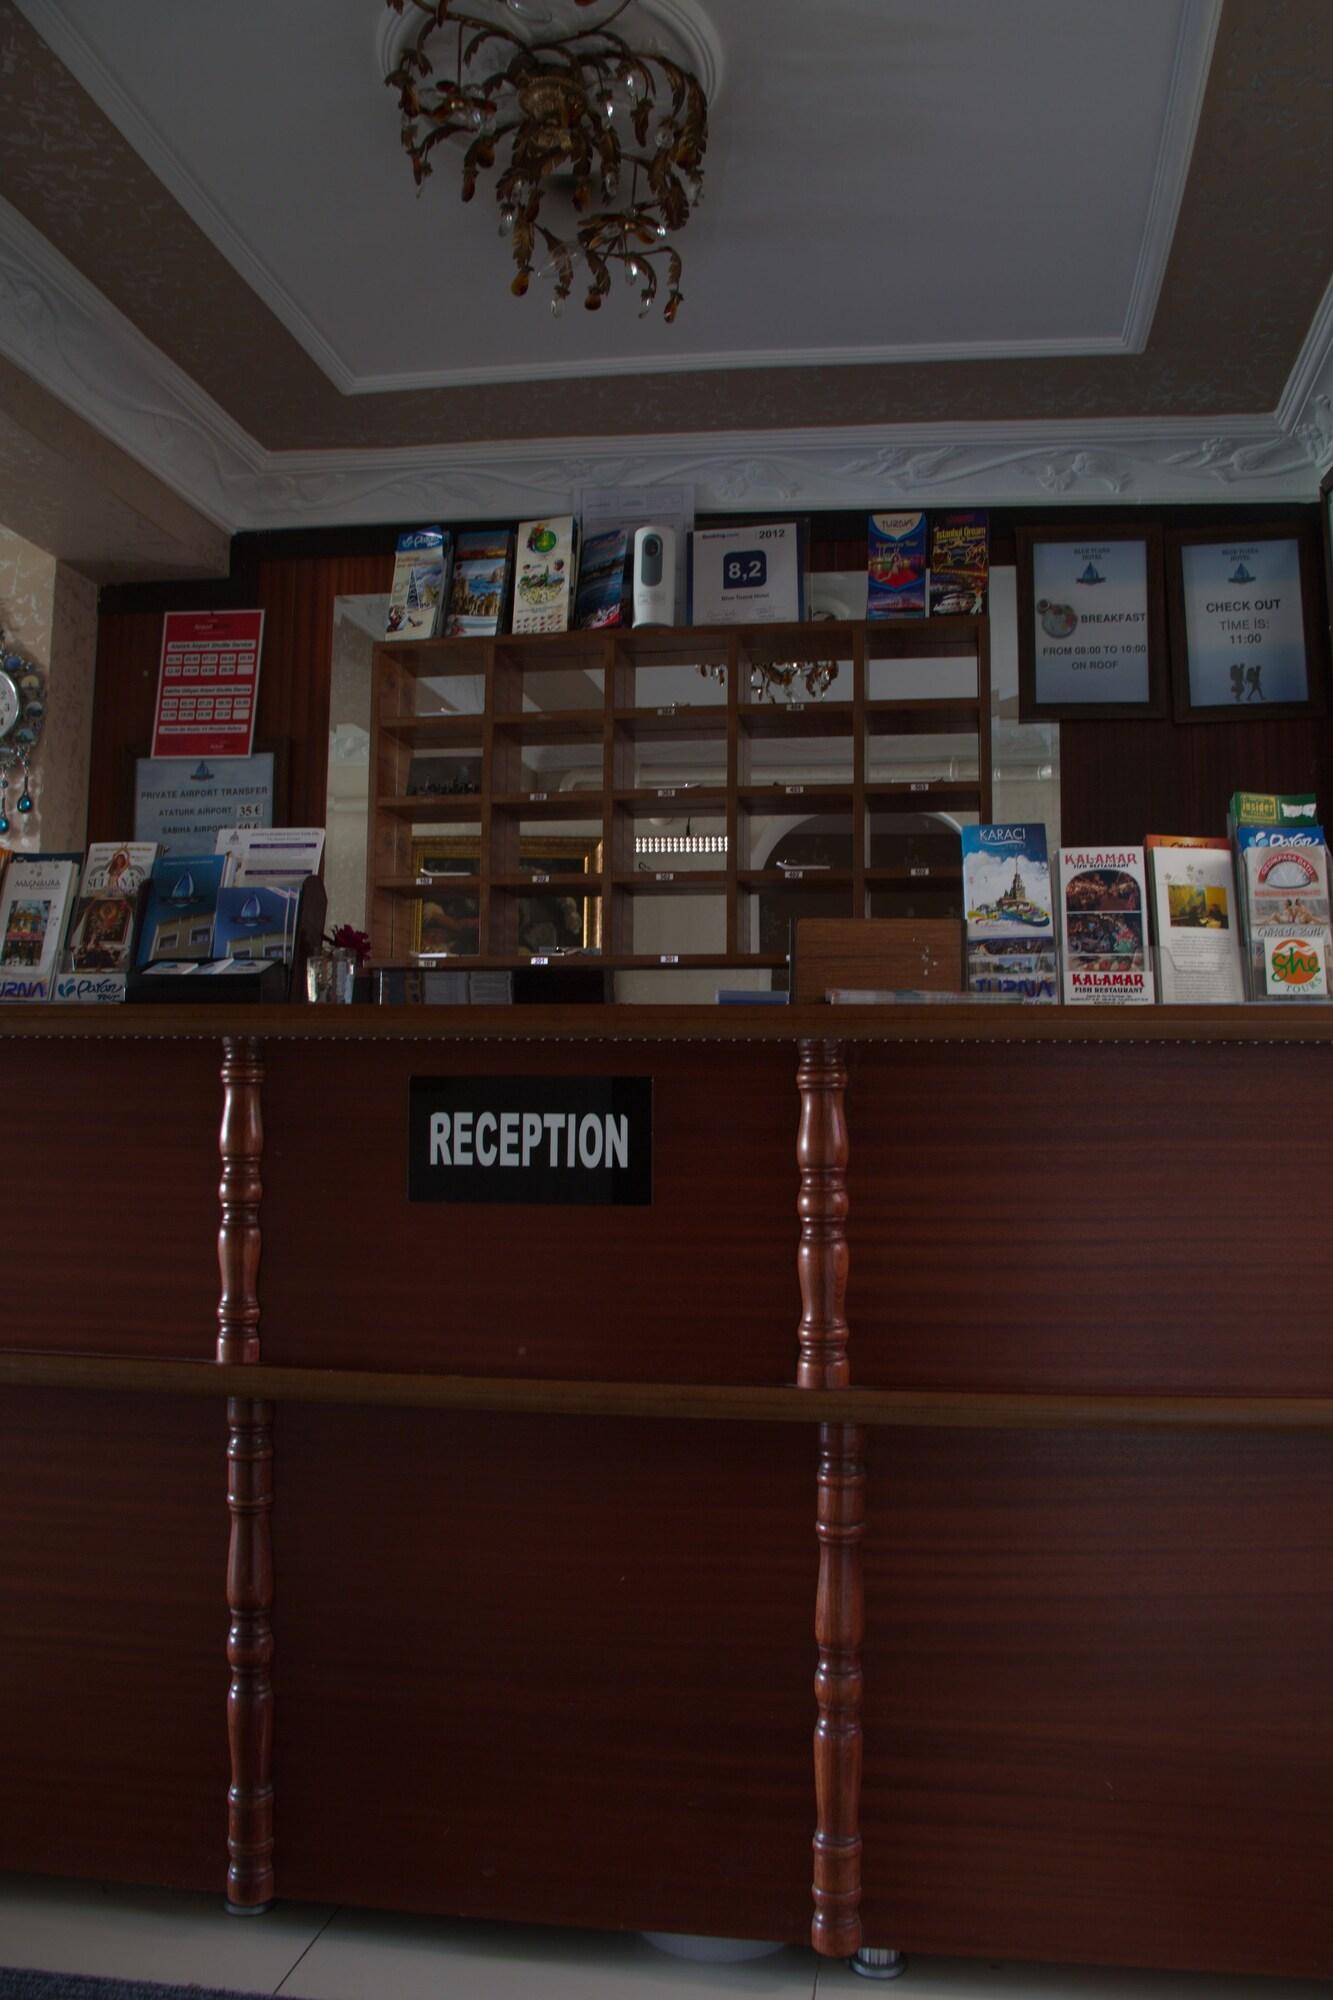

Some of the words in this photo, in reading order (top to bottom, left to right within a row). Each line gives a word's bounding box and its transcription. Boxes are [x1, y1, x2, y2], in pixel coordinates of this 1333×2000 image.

[759, 529, 785, 539] 2012
[728, 560, 762, 582] 8,2
[1206, 600, 1251, 613] CHECK
[1254, 599, 1280, 610] OUT
[1080, 613, 1146, 624] BREAKFAST
[1230, 633, 1262, 644] 11:00
[1043, 647, 1072, 656] FROM
[1104, 646, 1118, 654] TO
[1121, 645, 1147, 654] 10:00
[1071, 662, 1087, 671] ON
[1090, 660, 1119, 670] ROOF
[140, 790, 177, 800] PRIVATE
[180, 788, 218, 798] AIRPORT
[221, 786, 268, 796] TRANSFER
[197, 806, 232, 815] AIRPORT
[240, 805, 252, 816] 35
[980, 827, 1026, 841] KARACI
[1065, 853, 1137, 865] KALAMAR
[1072, 974, 1144, 987] KALAMAR
[429, 1111, 629, 1169] RECEPTION
